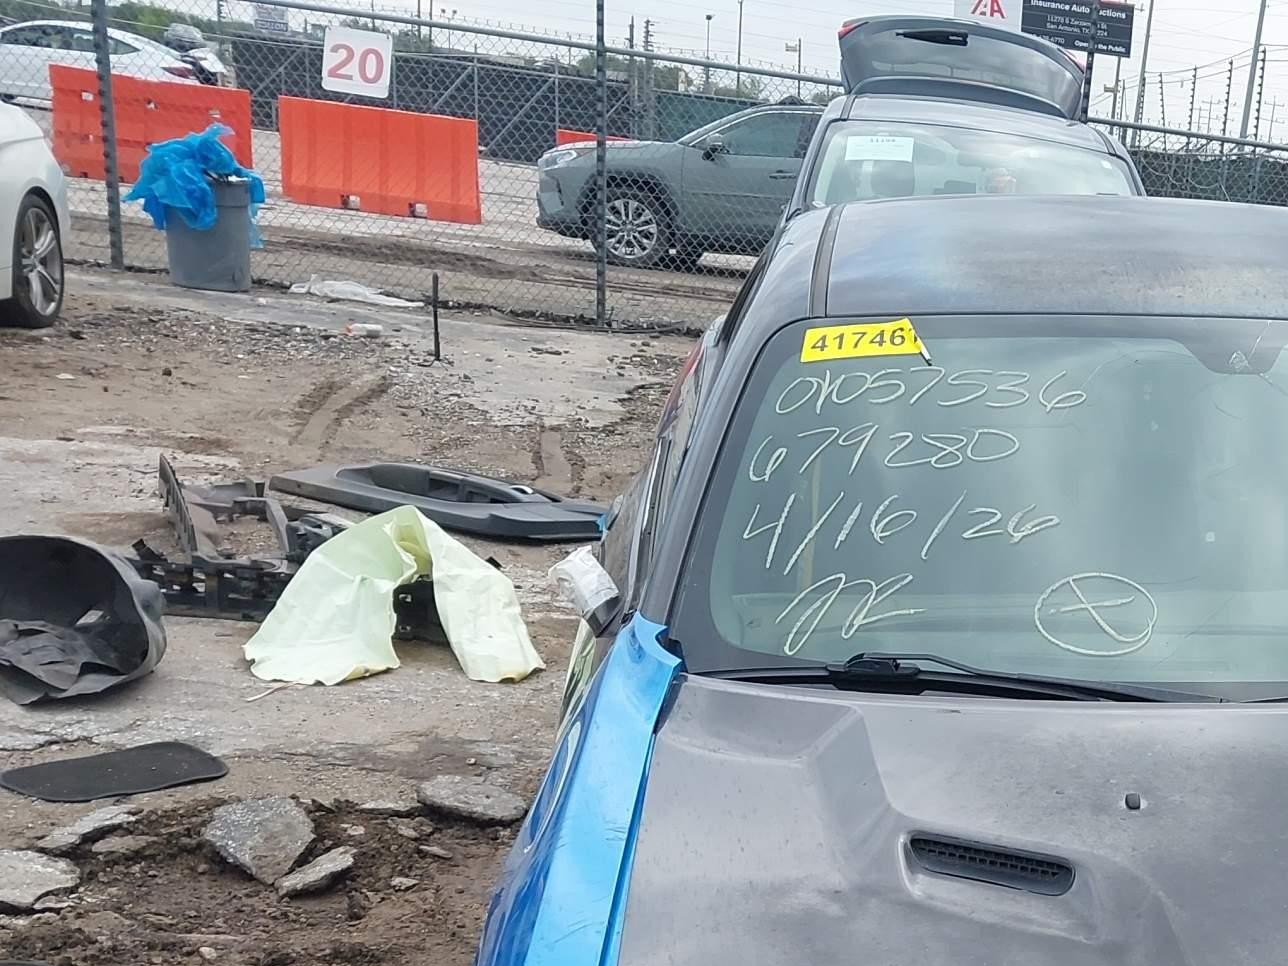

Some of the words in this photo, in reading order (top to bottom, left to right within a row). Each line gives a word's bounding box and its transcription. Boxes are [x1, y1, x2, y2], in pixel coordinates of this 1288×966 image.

[1031, 0, 1070, 11] Insurance
[1071, 4, 1090, 14] Auto
[1099, 9, 1126, 19] ctions
[327, 43, 384, 85] 20
[1108, 44, 1126, 52] Public
[749, 423, 1020, 482] 679280
[743, 489, 1061, 576] 4/16/26
